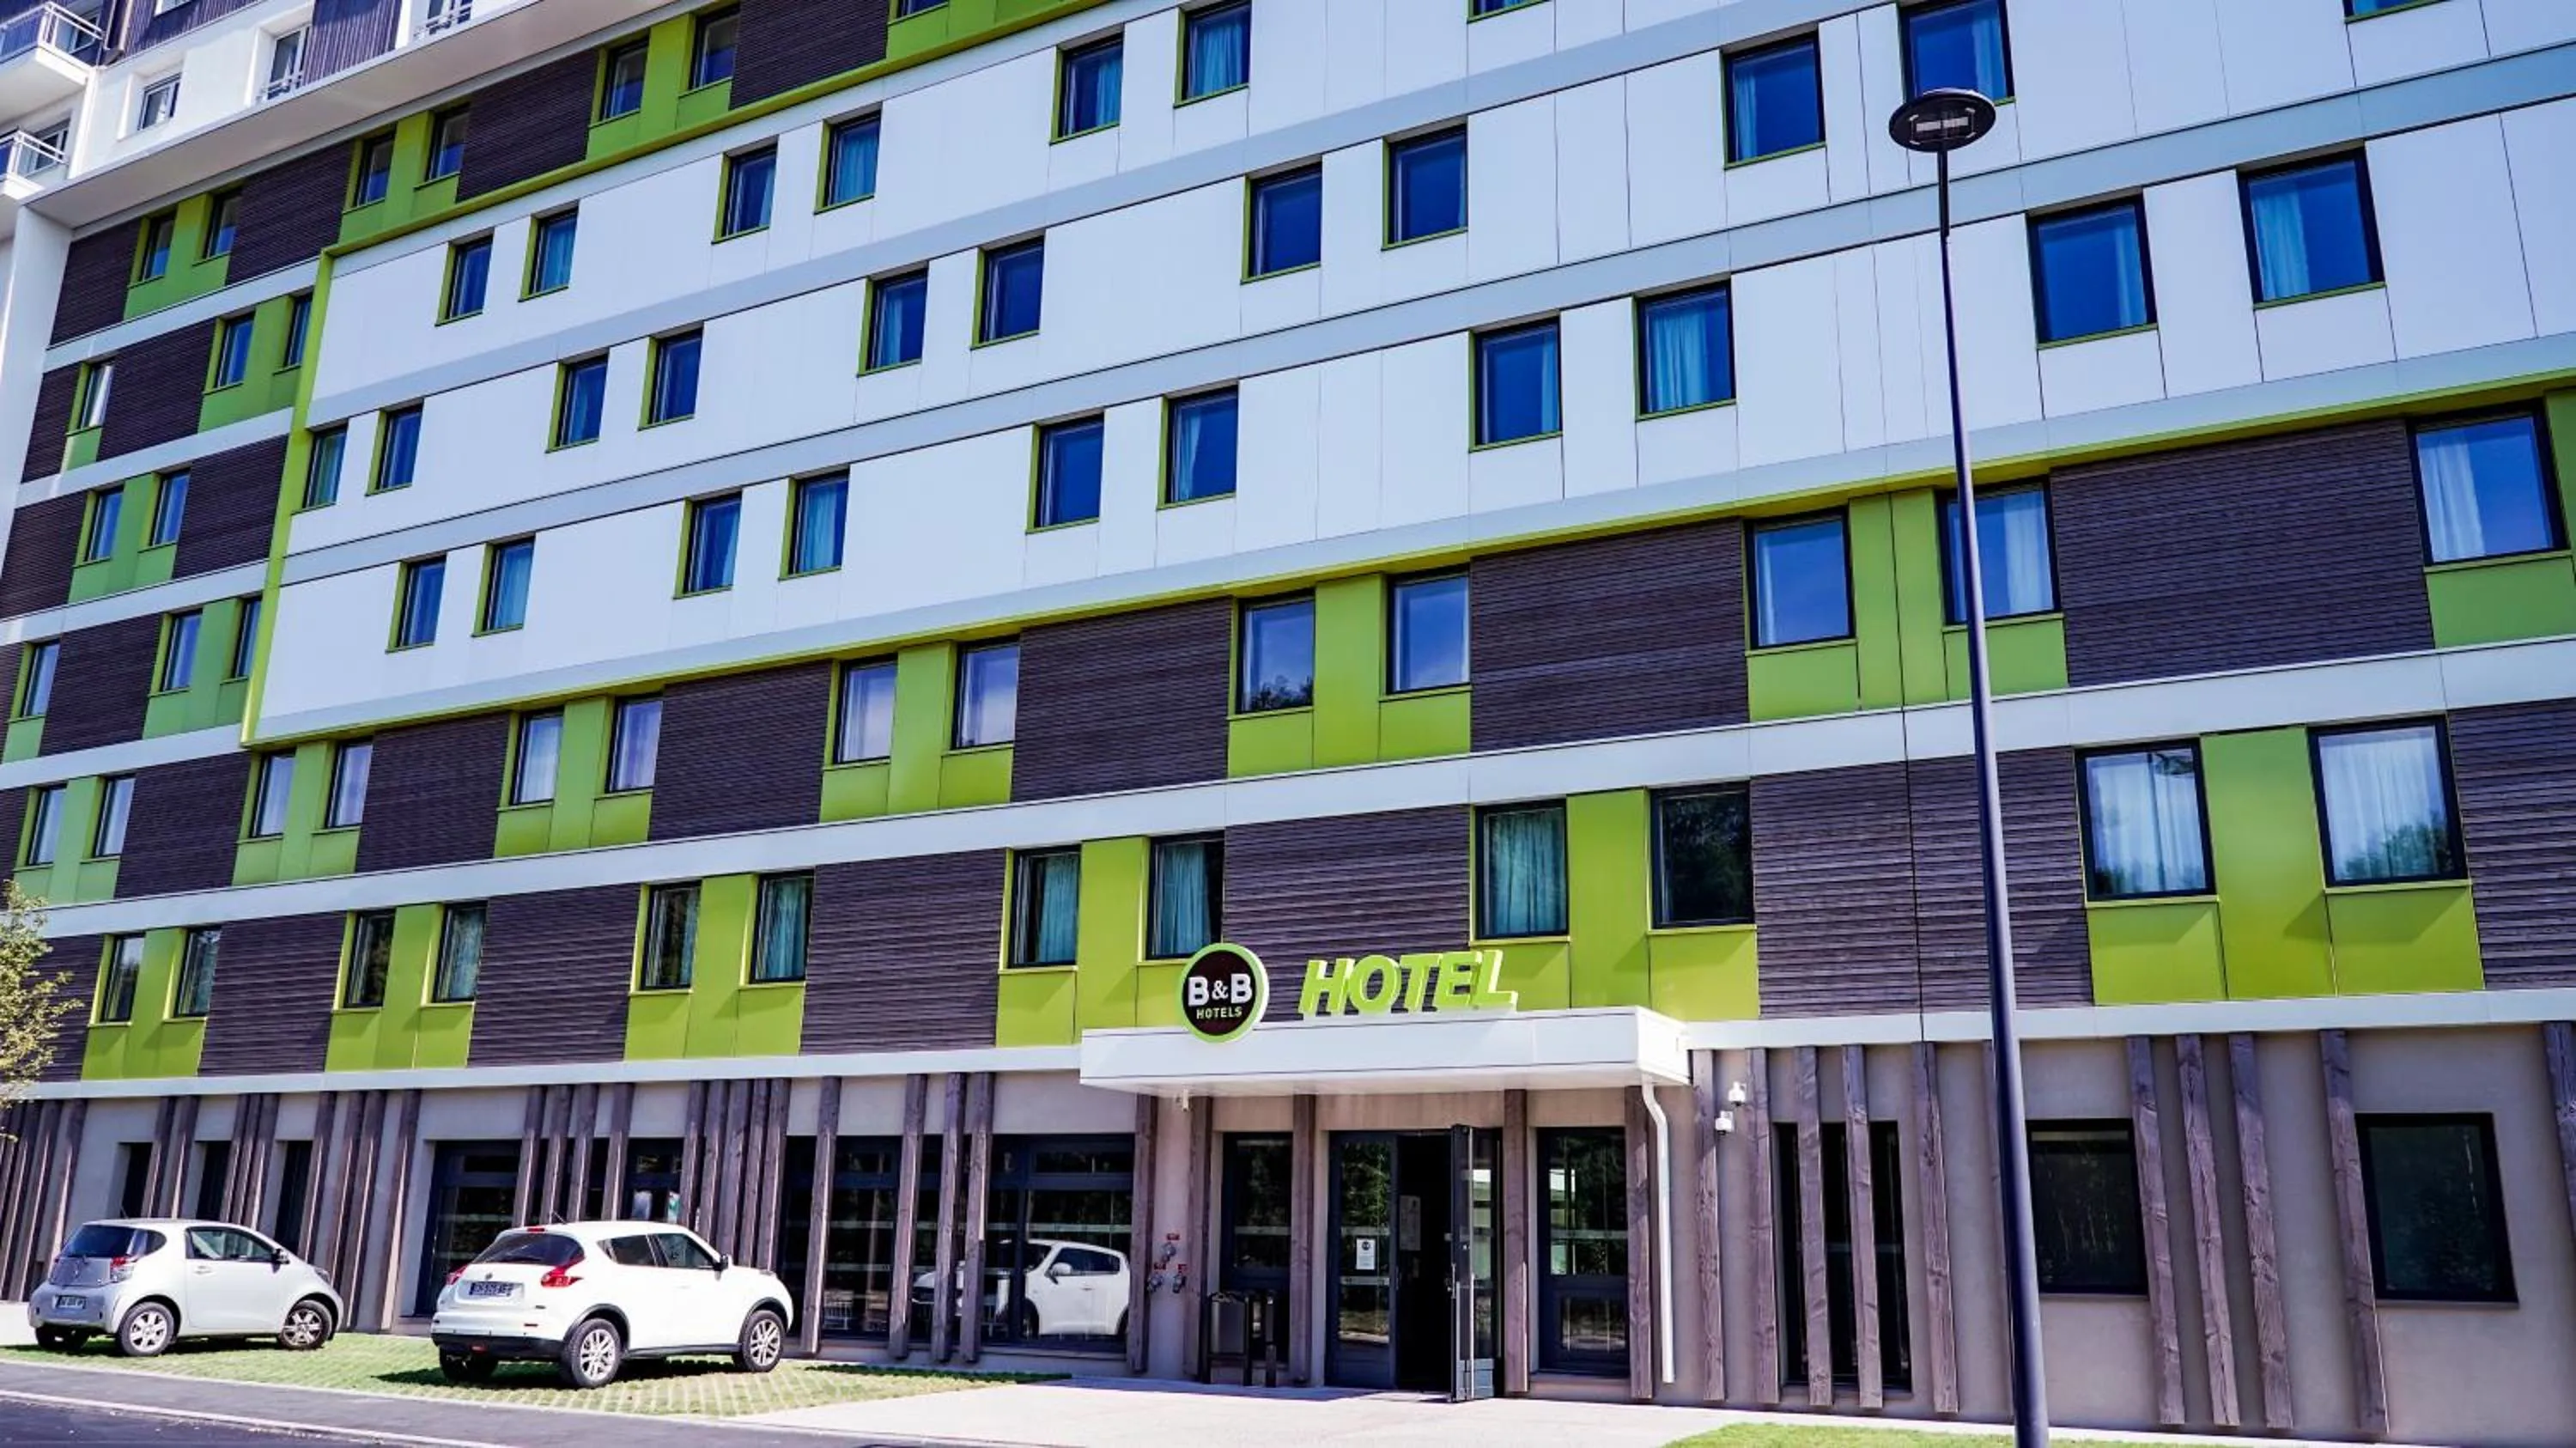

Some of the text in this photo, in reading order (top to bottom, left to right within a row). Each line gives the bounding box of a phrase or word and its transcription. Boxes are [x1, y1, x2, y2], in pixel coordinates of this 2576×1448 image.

[1188, 973, 1253, 1006] B&B
[1299, 950, 1516, 1013] HOTEL
[1196, 1007, 1242, 1019] HOTELS
